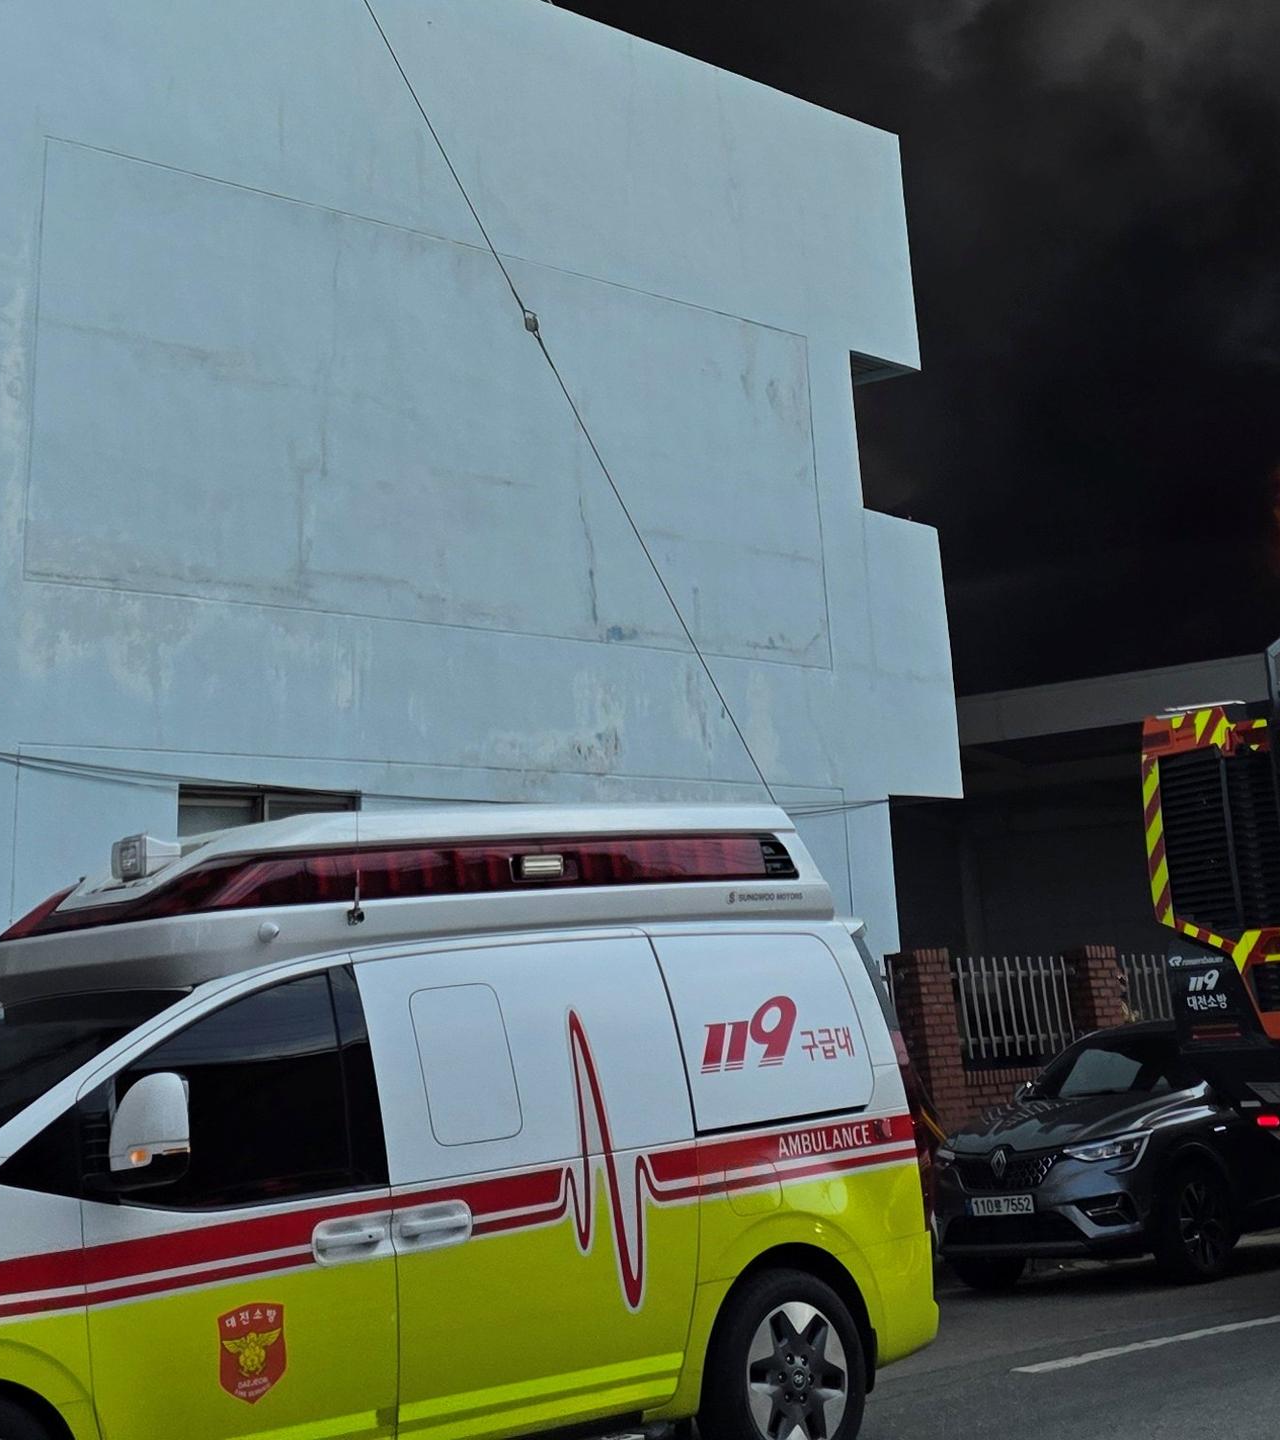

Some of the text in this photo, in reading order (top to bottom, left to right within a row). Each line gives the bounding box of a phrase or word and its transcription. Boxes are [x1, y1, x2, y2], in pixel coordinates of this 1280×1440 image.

[1188, 969, 1220, 992] 119
[1187, 993, 1228, 1011] 대전소방
[700, 995, 855, 1074] 119 구급대
[778, 1124, 872, 1158] AMBULANCE
[1003, 1197, 1032, 1213] 7552
[225, 1309, 277, 1329] 대전소방
